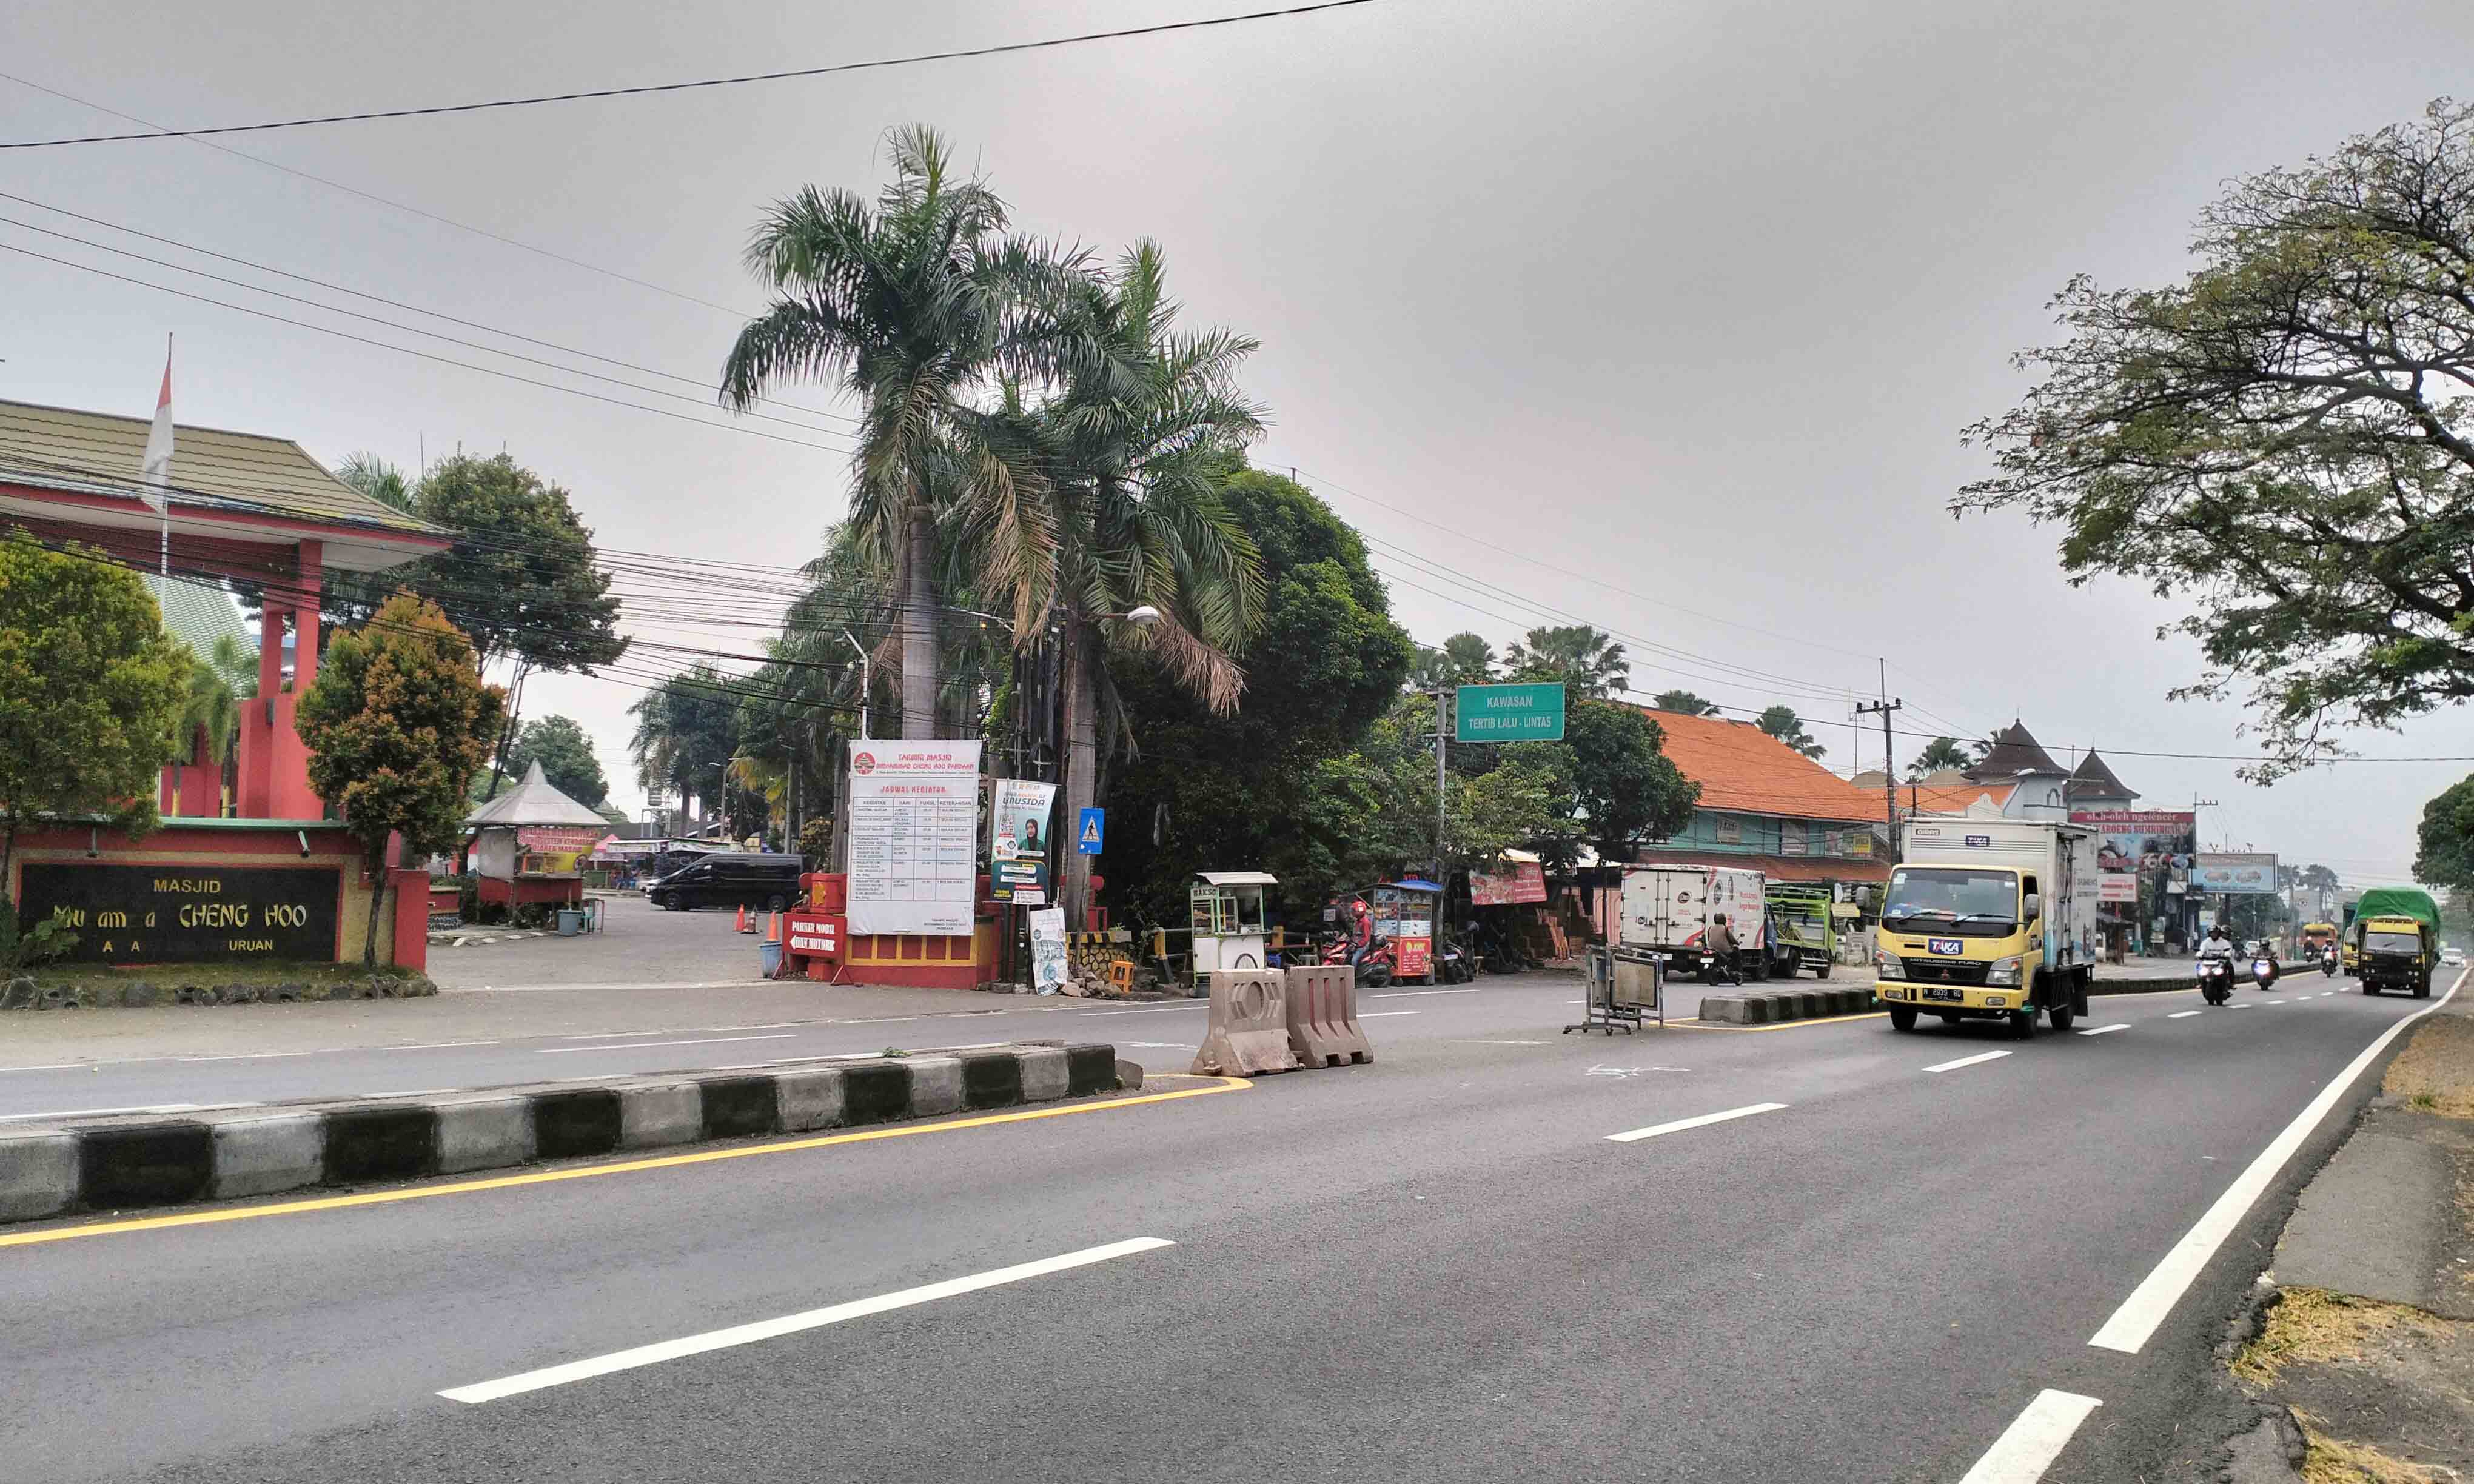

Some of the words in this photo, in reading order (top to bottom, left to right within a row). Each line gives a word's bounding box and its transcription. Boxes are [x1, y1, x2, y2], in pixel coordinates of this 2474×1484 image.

[1487, 696, 1533, 708] KAWASAN
[1469, 717, 1495, 730] TERTIB
[1498, 717, 1517, 729] LALU
[1524, 716, 1552, 728] LINTAS
[153, 879, 221, 893] MASJID
[1193, 887, 1216, 897] BAKSO
[179, 904, 249, 927] CHENG
[264, 904, 307, 927] HOO
[791, 921, 816, 932] PARKIR
[816, 923, 835, 935] MOBIL
[229, 940, 273, 951] URUAN
[1930, 940, 1960, 952] TAKA
